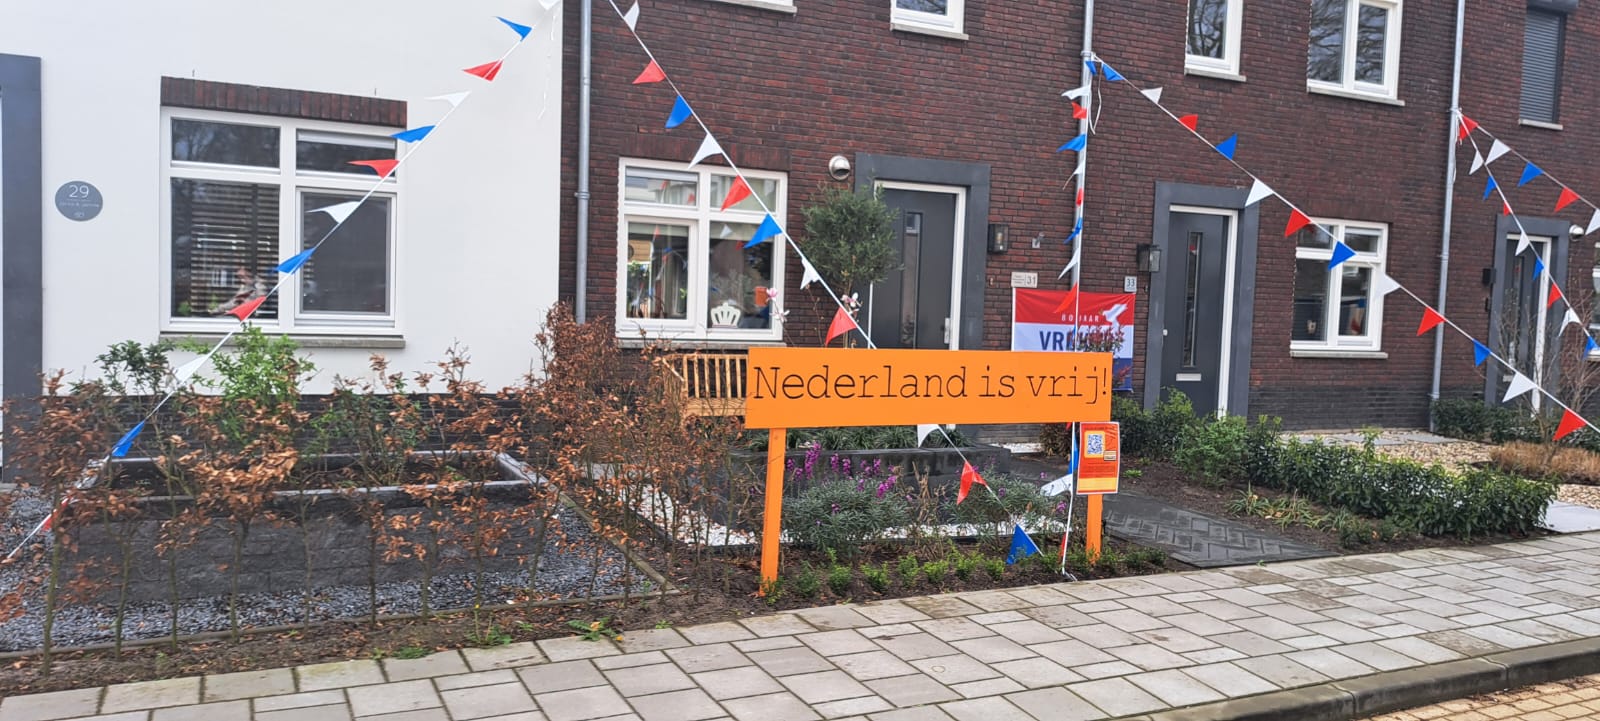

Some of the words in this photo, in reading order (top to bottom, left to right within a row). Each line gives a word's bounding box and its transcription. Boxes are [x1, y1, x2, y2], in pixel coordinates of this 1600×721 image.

[69, 184, 89, 198] 29
[1027, 275, 1036, 285] 31
[1126, 278, 1135, 287] 33
[753, 365, 968, 400] Nederland
[978, 365, 1015, 398] is
[1026, 366, 1108, 405] vrij!
